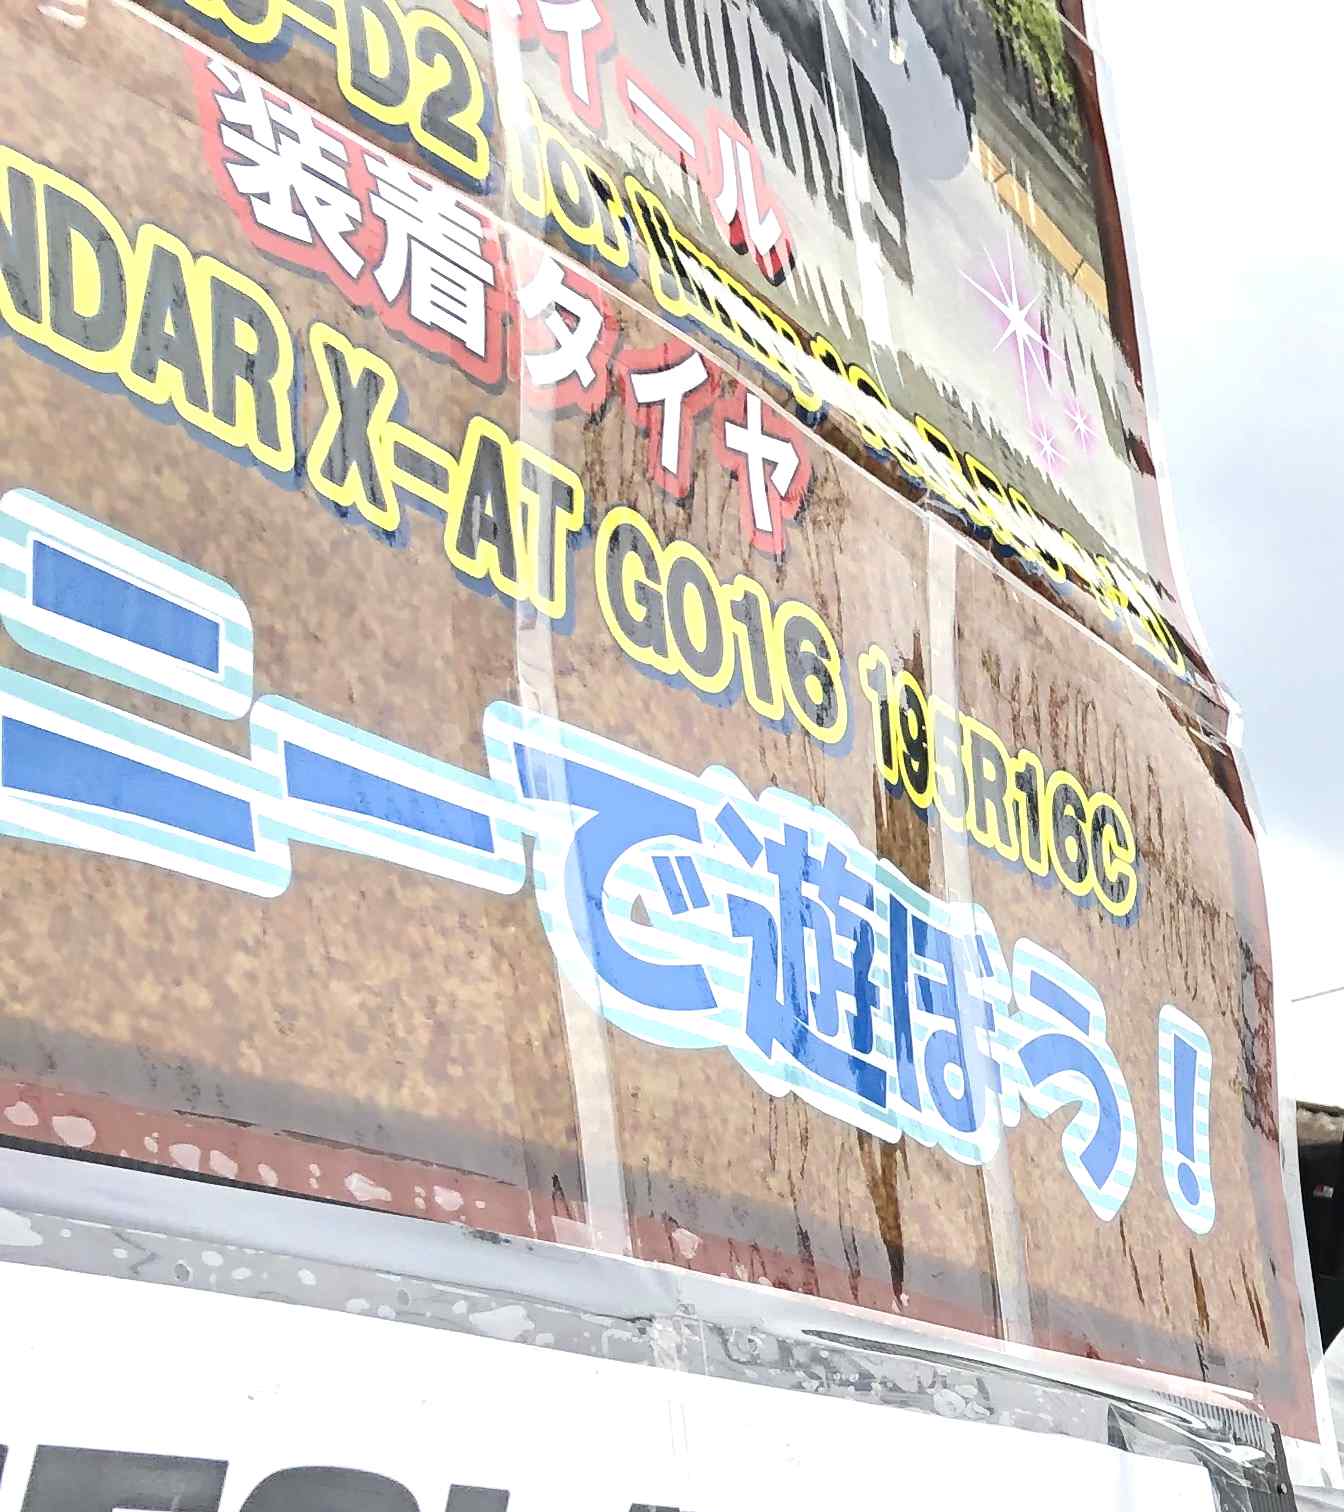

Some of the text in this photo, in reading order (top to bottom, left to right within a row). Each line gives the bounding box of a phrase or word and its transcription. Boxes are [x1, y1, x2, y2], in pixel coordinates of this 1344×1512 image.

[205, 55, 802, 535] 装着タイヤ
[458, 0, 790, 262] イール
[307, 322, 583, 617] X-AT
[858, 644, 1138, 916] 195R16C
